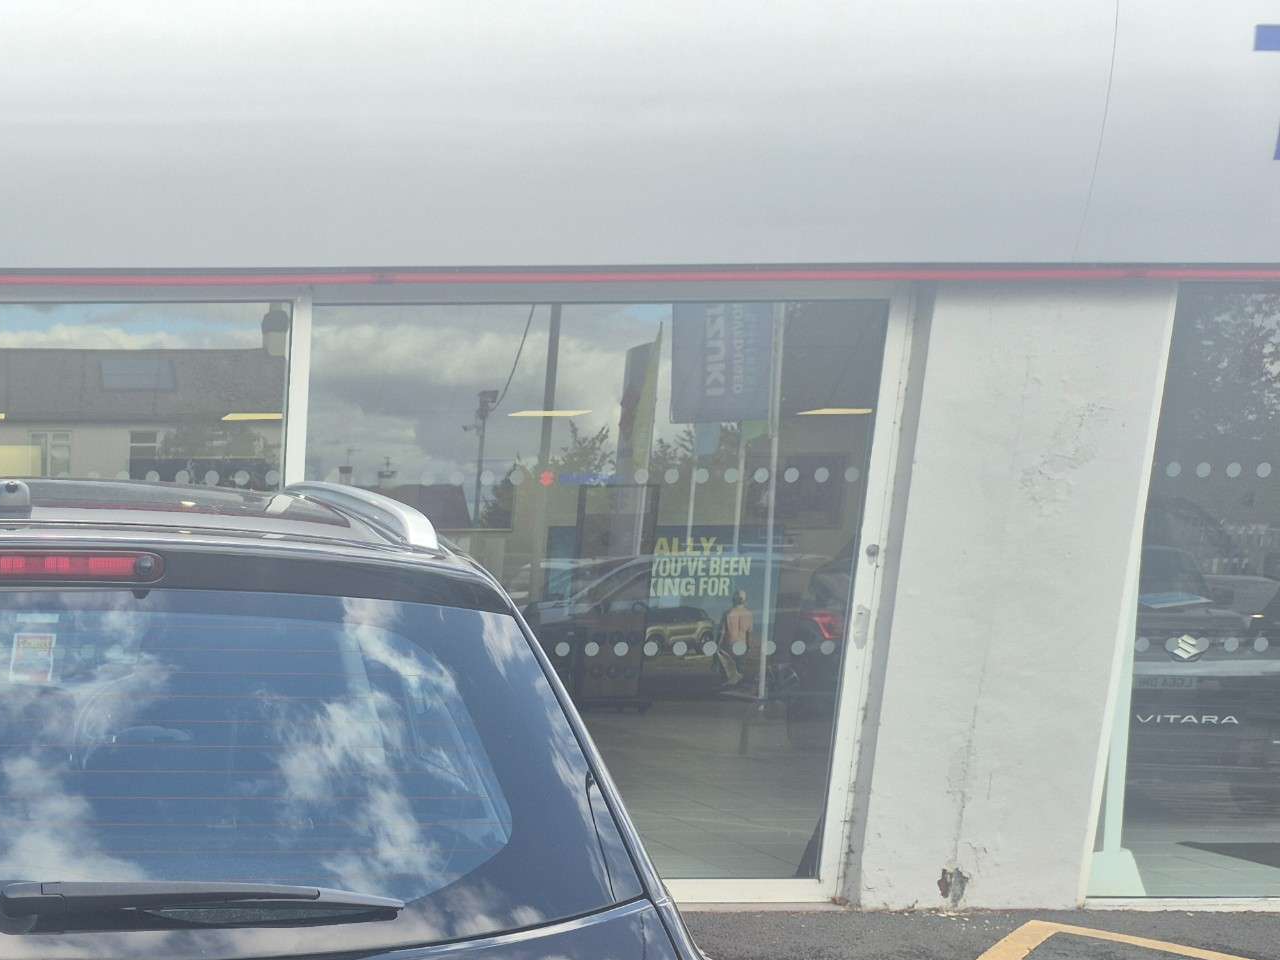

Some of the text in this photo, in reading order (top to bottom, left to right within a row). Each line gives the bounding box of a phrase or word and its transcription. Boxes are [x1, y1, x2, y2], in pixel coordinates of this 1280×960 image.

[708, 556, 752, 576] BEEN
[697, 577, 731, 596] FOR
[1135, 714, 1240, 725] VITARA
